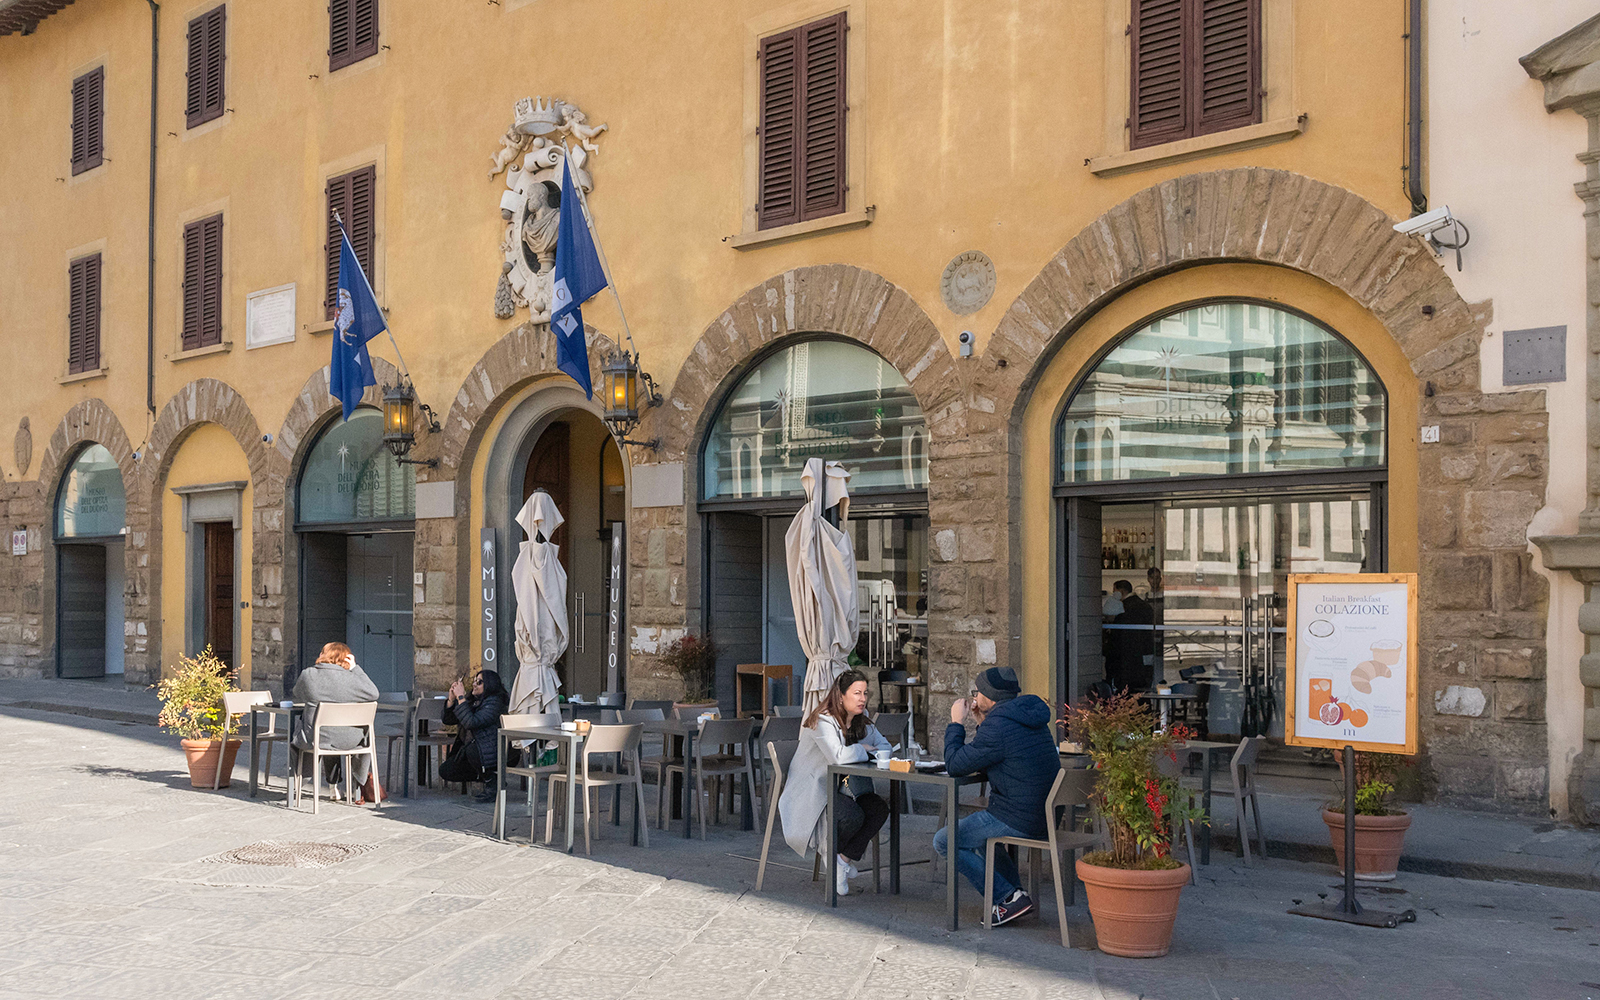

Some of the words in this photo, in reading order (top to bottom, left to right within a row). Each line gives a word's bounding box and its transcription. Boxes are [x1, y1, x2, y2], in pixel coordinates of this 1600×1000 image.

[798, 440, 850, 457] DUOMO
[351, 481, 379, 492] DOMO
[1322, 595, 1346, 603] Italian
[1347, 595, 1382, 603] Breakfast
[482, 566, 496, 662] MUSEO
[608, 564, 620, 668] MUSEO
[1314, 604, 1390, 615] COLAZIONE
